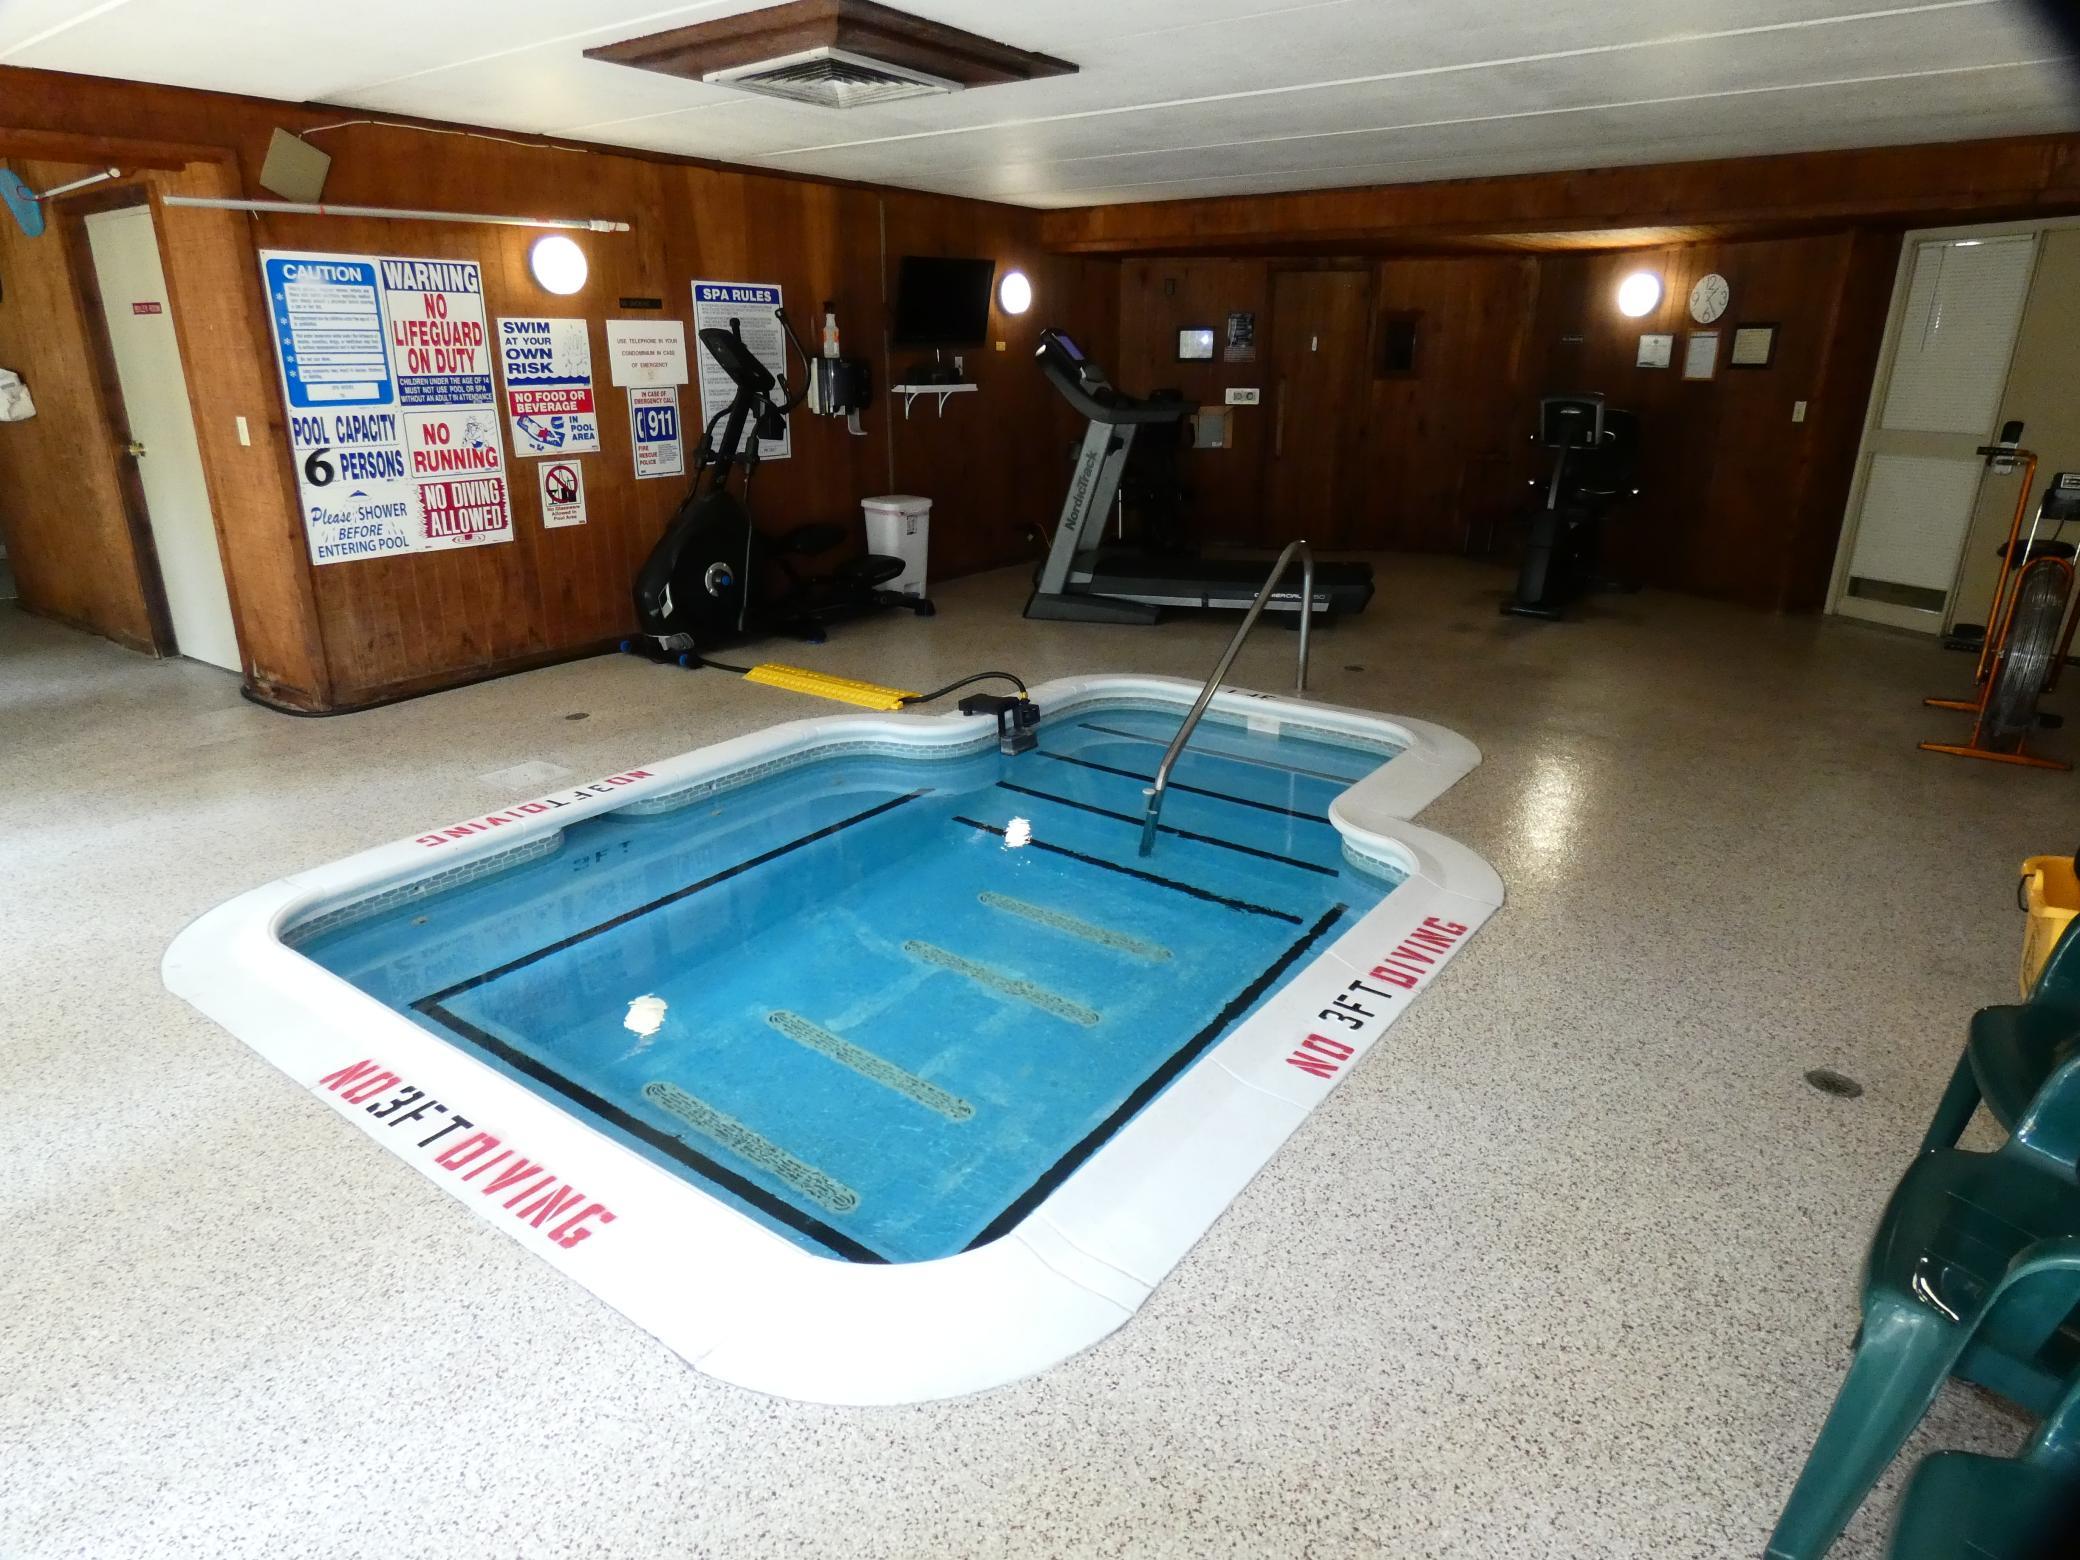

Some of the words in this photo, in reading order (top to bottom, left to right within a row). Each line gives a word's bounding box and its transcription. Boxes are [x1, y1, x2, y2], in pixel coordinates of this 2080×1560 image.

[282, 264, 363, 281] CAUTION
[382, 261, 479, 293] WARNING
[423, 293, 448, 319] NO
[703, 288, 719, 300] SPA
[732, 289, 772, 302] RULES
[393, 320, 483, 347] LIFEGUARD
[503, 322, 551, 334] SWIM
[523, 337, 552, 345] YOUR
[407, 348, 431, 374] ON
[434, 348, 475, 374] DUTY
[506, 348, 553, 360] OWN
[508, 362, 554, 374] RISK
[400, 378, 429, 386] CHILDREN
[450, 377, 461, 385] THE
[462, 377, 473, 385] AGE
[483, 376, 490, 384] 14
[422, 386, 434, 394] NOT
[475, 385, 487, 393] SPA
[400, 394, 425, 403] WITHOUT
[426, 394, 435, 402] AN
[435, 394, 452, 402] ADULT
[459, 393, 493, 401] ATTENDANCE
[514, 393, 532, 403] NO
[535, 391, 567, 402] FOOD
[569, 390, 585, 401] OR
[516, 401, 578, 413] BEVERAGE
[291, 416, 330, 446] POOL
[335, 414, 396, 444] CAPACITY
[422, 423, 451, 446] NO
[571, 424, 594, 432] POOL
[648, 410, 673, 437] 911
[572, 432, 595, 440] AREA
[304, 447, 335, 487] 6
[340, 450, 405, 480] PERSONS
[413, 446, 499, 473] RUNNING
[424, 484, 447, 511] NO
[451, 479, 502, 508] DIVING
[1064, 450, 1098, 531] NordicTrack
[310, 506, 351, 527] Please
[358, 503, 407, 521] SHOWER
[431, 505, 503, 537] ALLOWED
[338, 524, 384, 541] BEFORE
[318, 539, 377, 558] ENTERING
[379, 536, 410, 550] POOL
[605, 771, 654, 785] NO
[415, 803, 550, 847] DIVING
[1286, 1033, 1355, 1079] NO
[1369, 917, 1468, 989] DIVING
[319, 1059, 403, 1105] NO
[434, 1132, 617, 1249] DIVING
